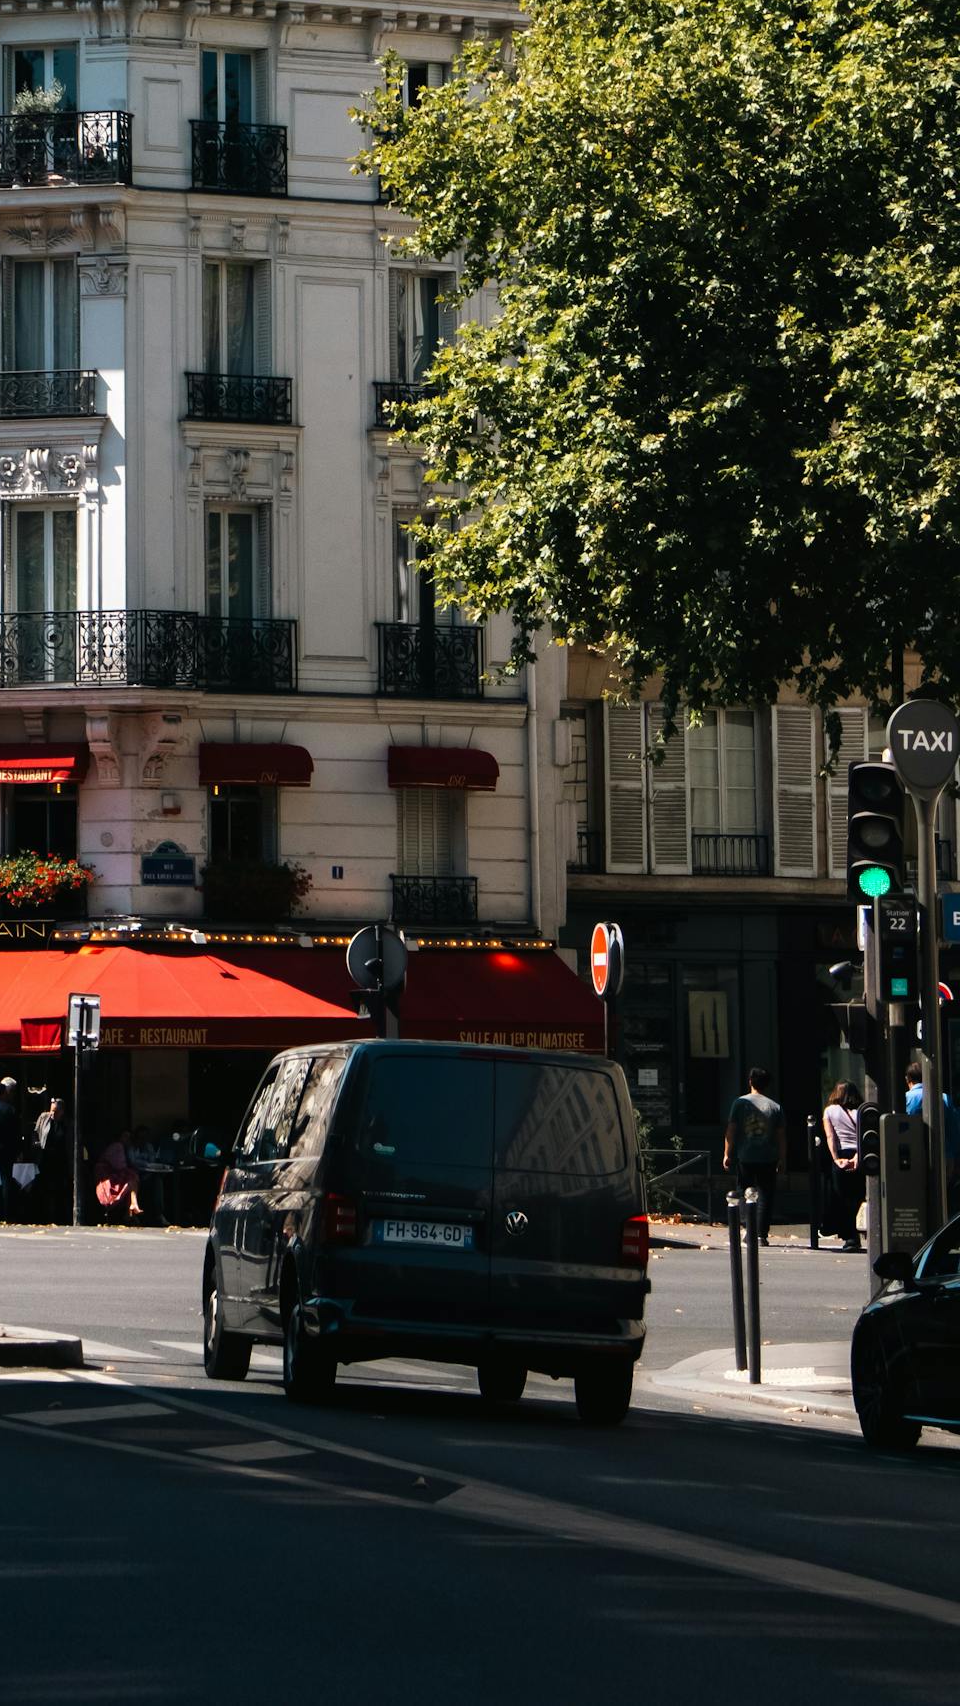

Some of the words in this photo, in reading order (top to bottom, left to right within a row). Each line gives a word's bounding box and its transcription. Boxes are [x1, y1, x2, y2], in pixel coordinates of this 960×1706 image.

[897, 729, 952, 752] TAXI
[886, 909, 910, 917] Station
[890, 917, 906, 930] 22
[140, 1029, 208, 1044] RESTAURANT
[459, 1031, 490, 1044] SALLE
[527, 1032, 584, 1049] CLIMATISEE
[386, 1221, 462, 1243] FH-964-GD
